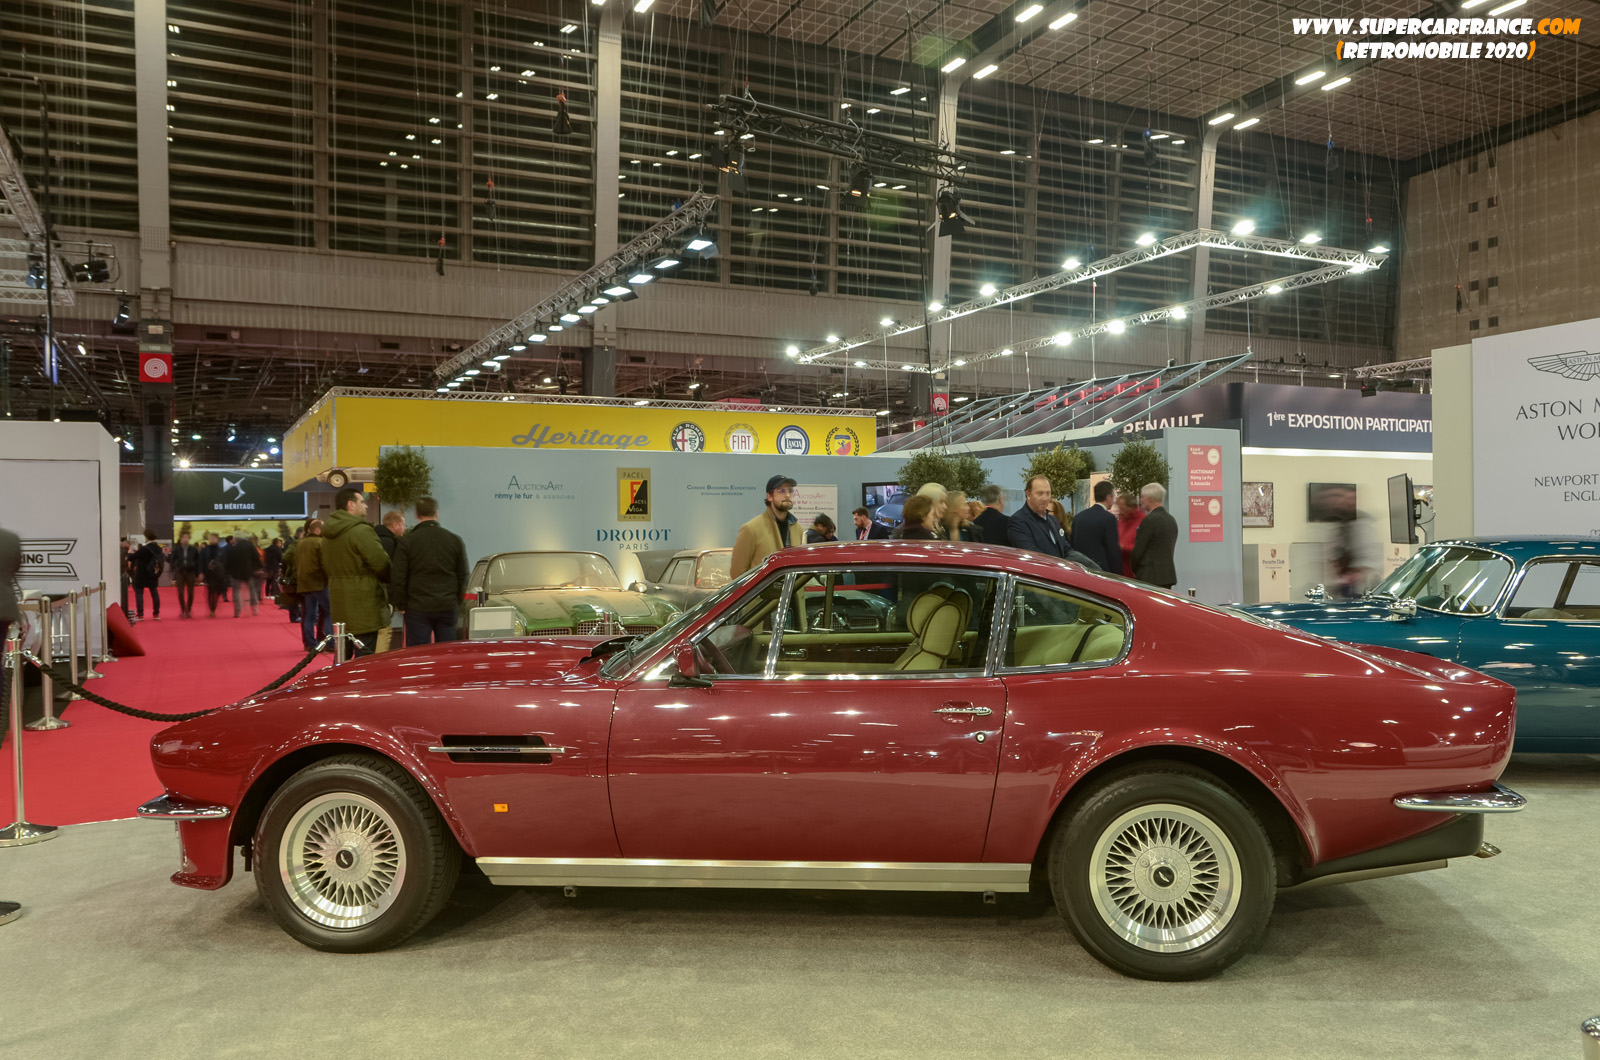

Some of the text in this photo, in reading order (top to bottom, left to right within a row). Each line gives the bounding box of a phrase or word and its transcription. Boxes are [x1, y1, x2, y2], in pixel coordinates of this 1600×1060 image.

[1567, 355, 1592, 365] ASTON
[1515, 398, 1582, 420] ASTON
[1267, 411, 1286, 427] 1ère
[1288, 413, 1363, 431] EXPOSITION
[511, 423, 651, 450] Heritage
[672, 423, 704, 442] ALFA ROMEO
[1557, 422, 1600, 440] WO
[731, 434, 752, 450] FIAT
[622, 471, 645, 479] FACEL
[1534, 473, 1599, 487] NEWPORT
[523, 492, 533, 500] fur
[1563, 490, 1600, 502] ENGL
[224, 502, 256, 510] HÉRITAGE
[596, 528, 672, 542] DROUOT
[619, 543, 649, 551] PARIS
[20, 553, 44, 564] ING
